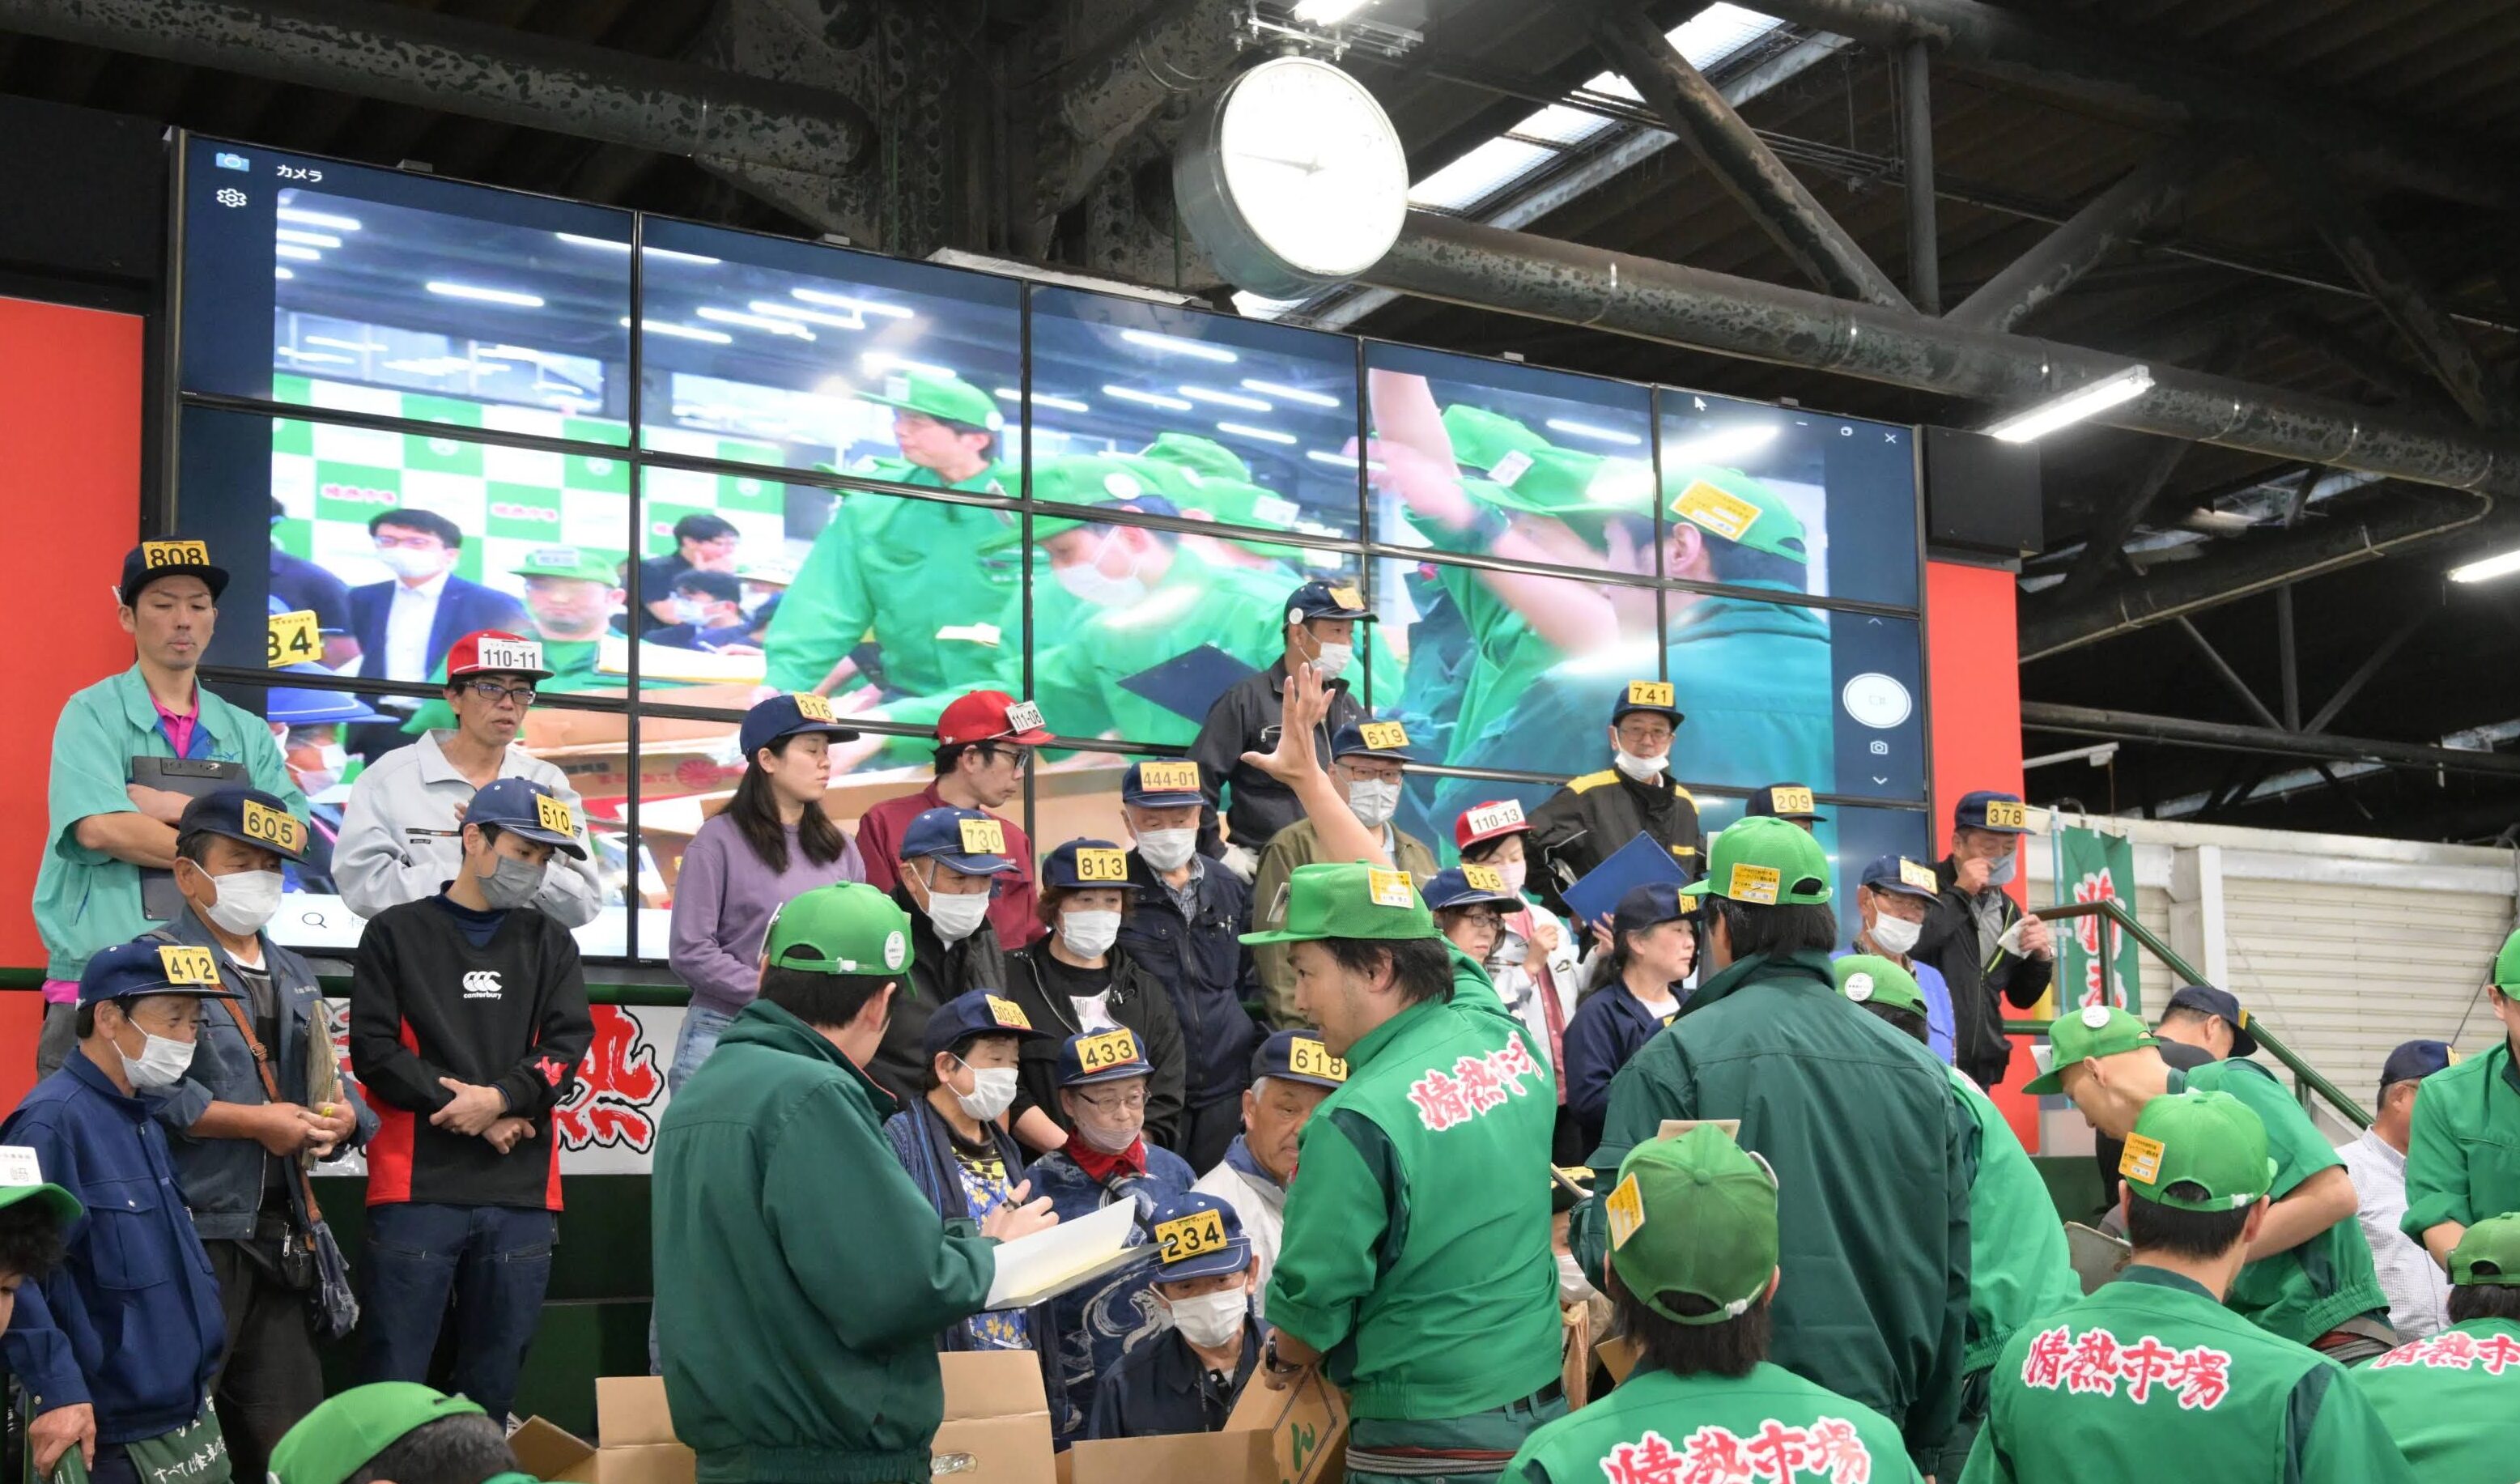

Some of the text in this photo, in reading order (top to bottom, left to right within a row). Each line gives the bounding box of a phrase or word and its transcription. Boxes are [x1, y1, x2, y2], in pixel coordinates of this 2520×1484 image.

[277, 164, 323, 182] カメラ
[151, 547, 204, 567] 808
[483, 648, 536, 669] 110-11
[1634, 687, 1666, 702] 741
[800, 699, 832, 719] 316
[1012, 709, 1042, 729] 111-08
[1367, 729, 1403, 746] 619
[1143, 771, 1196, 786] 444-01
[1776, 794, 1810, 810] 209
[542, 805, 569, 831] 510
[1473, 809, 1519, 831] 110-13
[1990, 808, 2022, 825] 378
[249, 812, 292, 844] 605
[965, 828, 1001, 848] 730
[1082, 857, 1123, 876] 813
[1468, 871, 1501, 888] 316
[171, 957, 214, 980] 412
[463, 992, 502, 1000] canterbury
[1086, 1039, 1133, 1067] 433
[1295, 1048, 1342, 1076] 618
[1163, 1222, 1220, 1257] 234
[2022, 1325, 2232, 1410] 情熱市場
